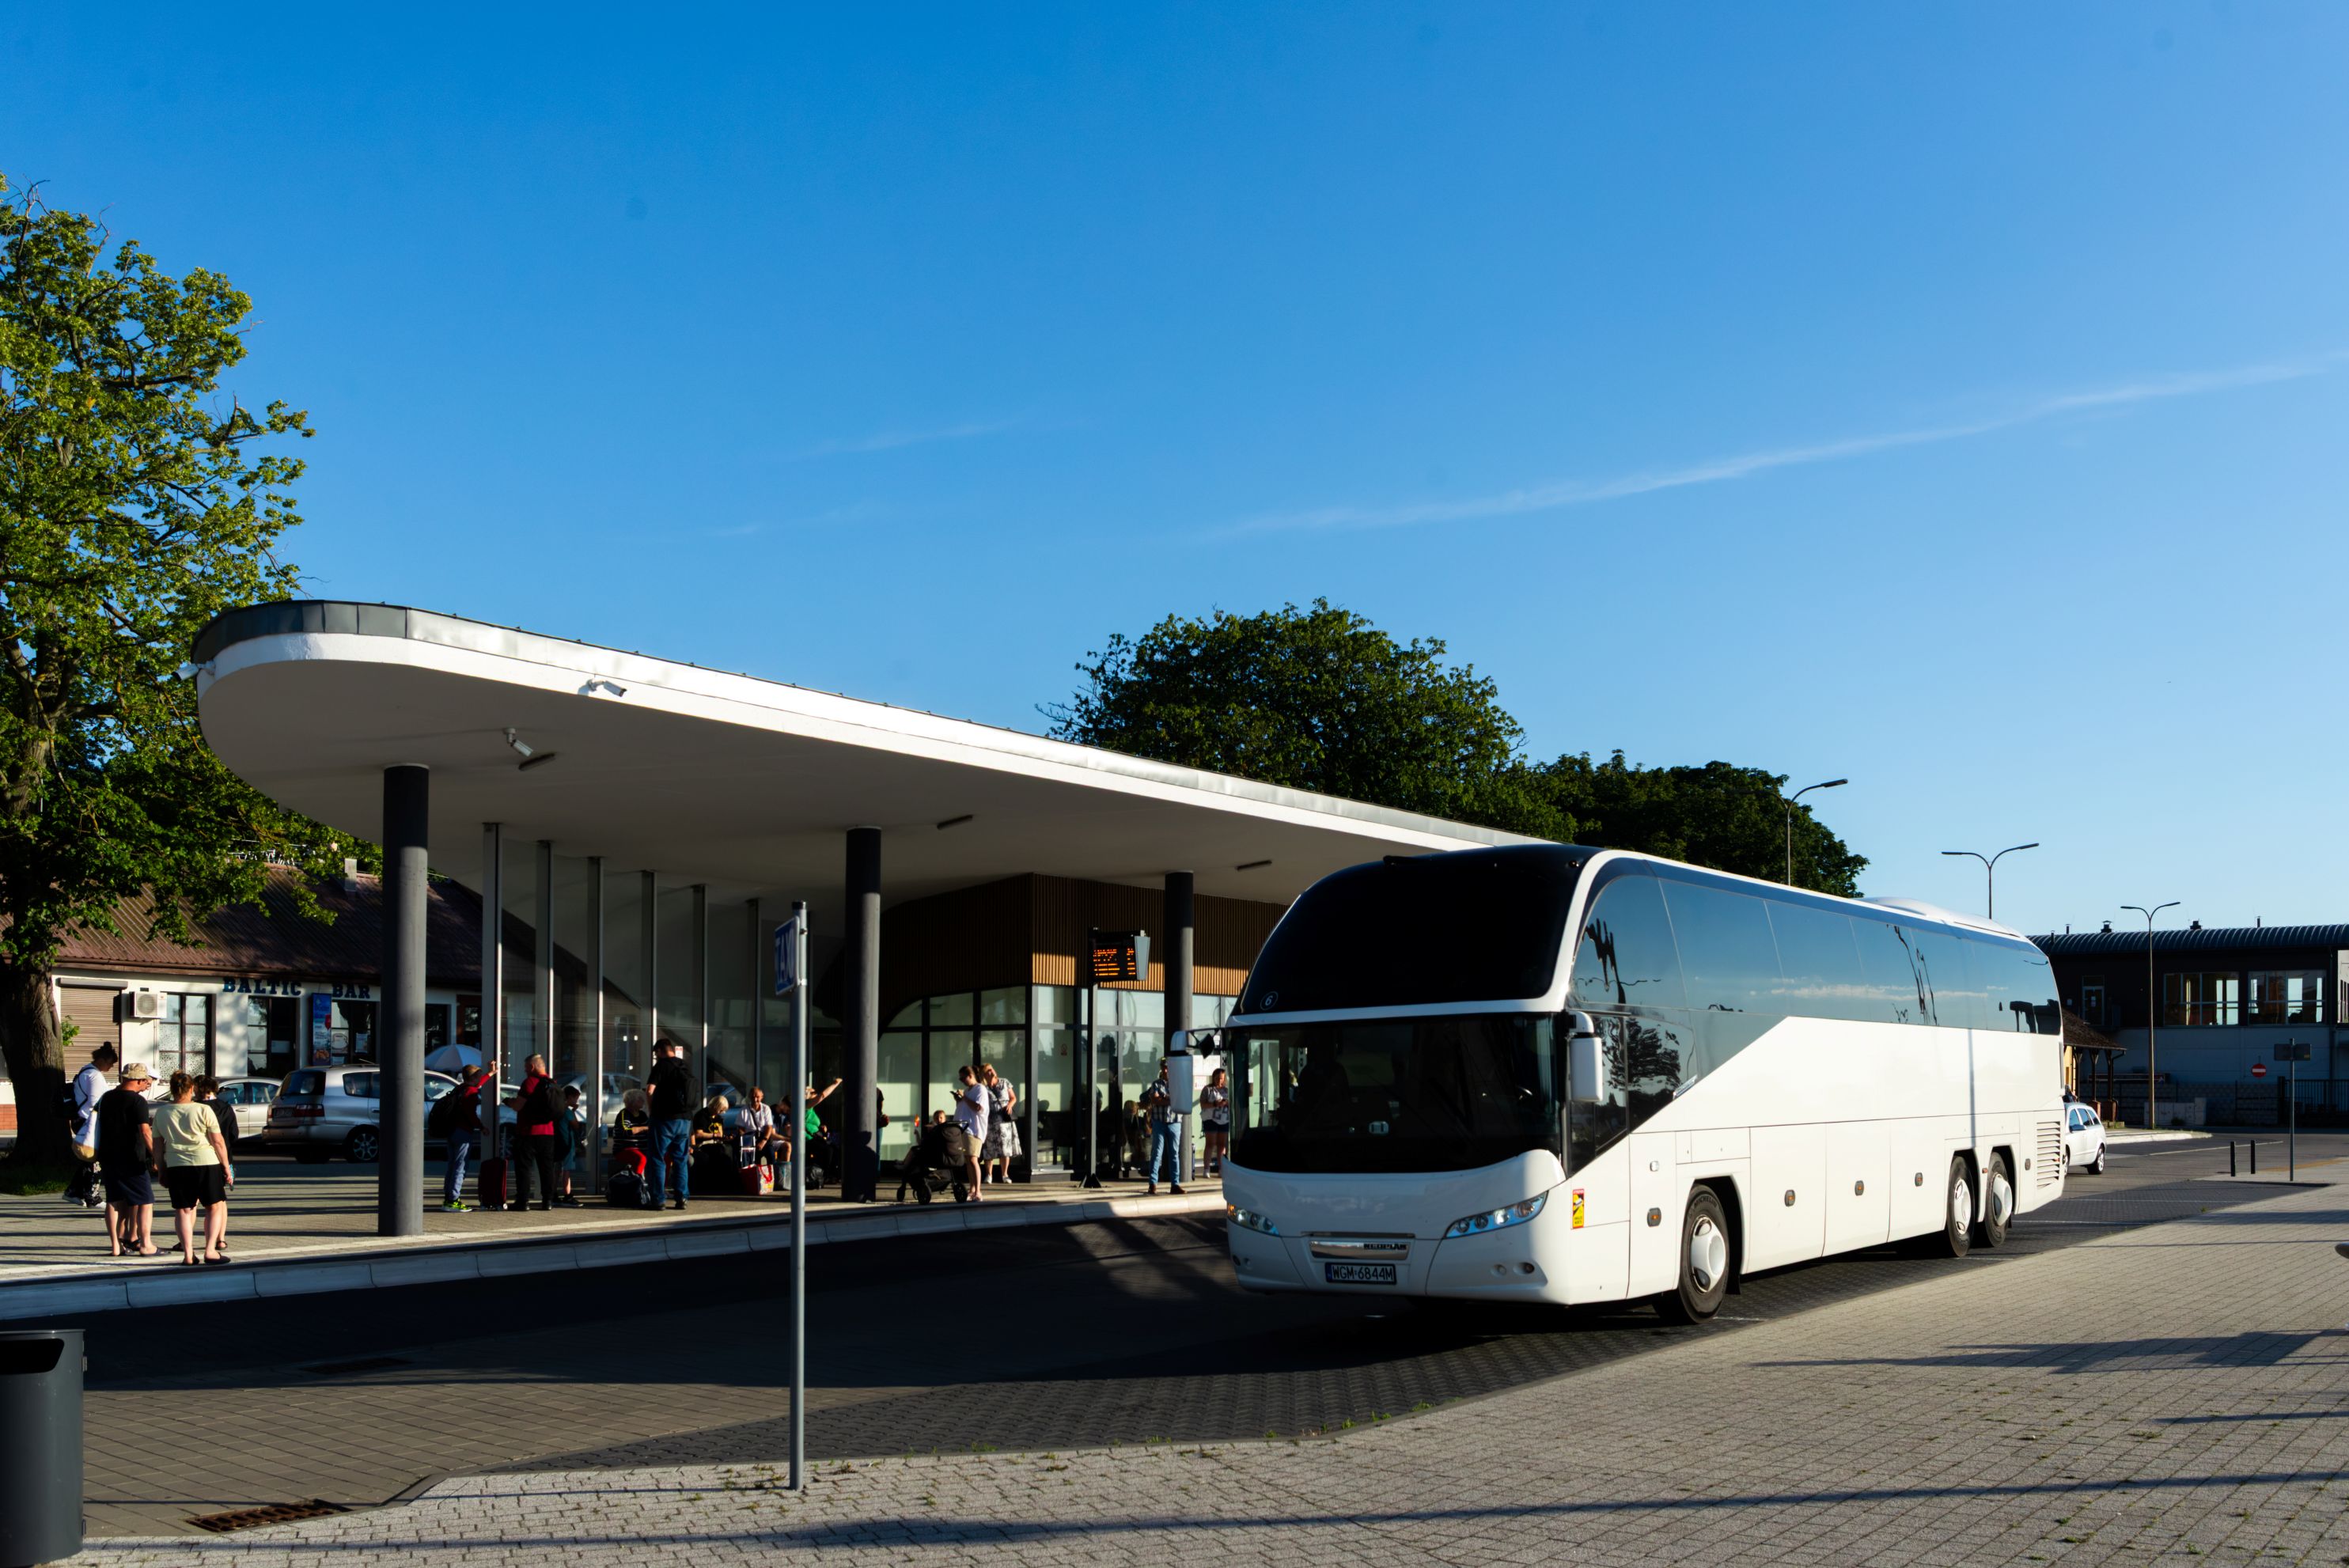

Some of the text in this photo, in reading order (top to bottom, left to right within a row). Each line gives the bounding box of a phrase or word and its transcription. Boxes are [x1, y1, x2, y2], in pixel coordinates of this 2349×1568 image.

[222, 976, 371, 999] BALTIC BAR
[1332, 1265, 1393, 1281] WGM 6844M
